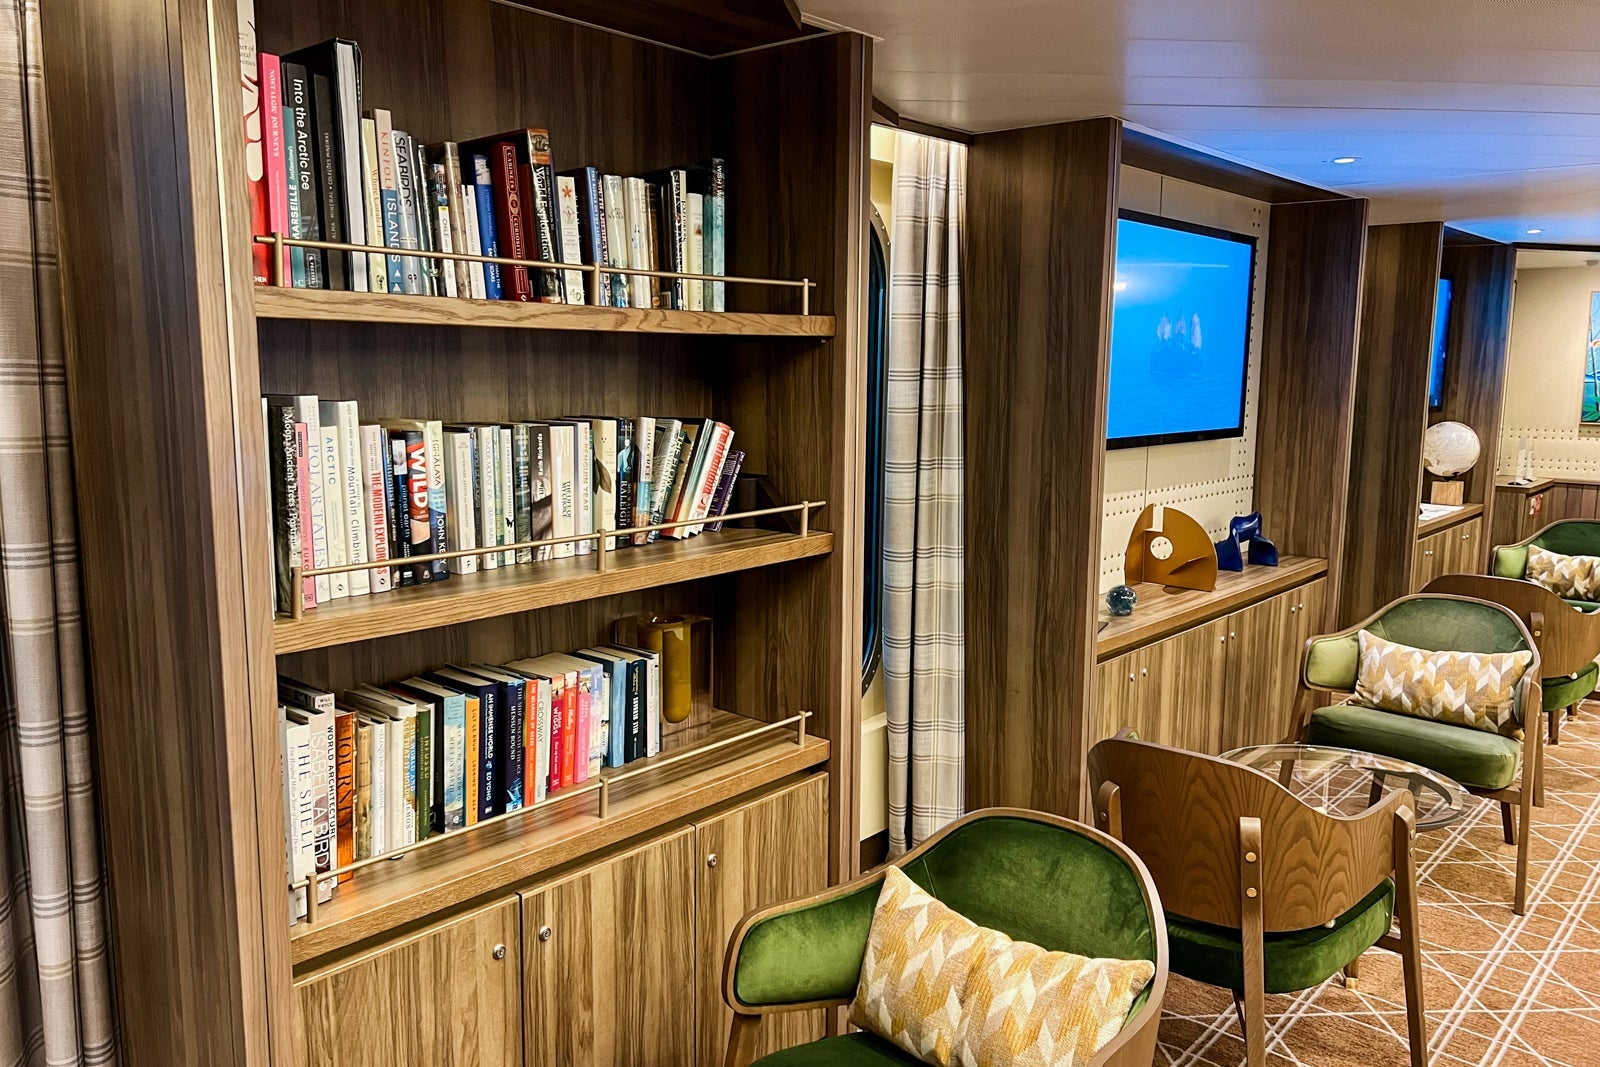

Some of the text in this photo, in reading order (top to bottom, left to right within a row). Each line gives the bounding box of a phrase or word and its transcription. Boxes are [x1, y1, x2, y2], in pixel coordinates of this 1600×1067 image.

[270, 69, 280, 158] NOSTALGIC JOURNEYS
[293, 78, 310, 190] Into the Arctic Ice
[290, 184, 300, 240] MARSEILLE
[328, 189, 336, 220] MINERAL
[386, 197, 400, 263] ISLANDS
[535, 166, 549, 260] World Exploration
[513, 217, 522, 260] CURIOSITIE
[286, 447, 296, 482] Ancient
[308, 445, 322, 507] POLAR
[326, 437, 336, 485] ARCTIC
[408, 443, 428, 508] WILD
[666, 434, 685, 489] THE FLOW
[313, 510, 326, 567] TALES
[348, 467, 361, 566] Mountain Climbing
[371, 472, 388, 575] THE MODERN EXPLORS
[436, 515, 445, 540] JOHN
[438, 542, 446, 565] KEY
[298, 740, 313, 856] THE SHELL
[311, 730, 330, 867] ISABELLA BIRD
[328, 764, 336, 841] ARCHITECTURE
